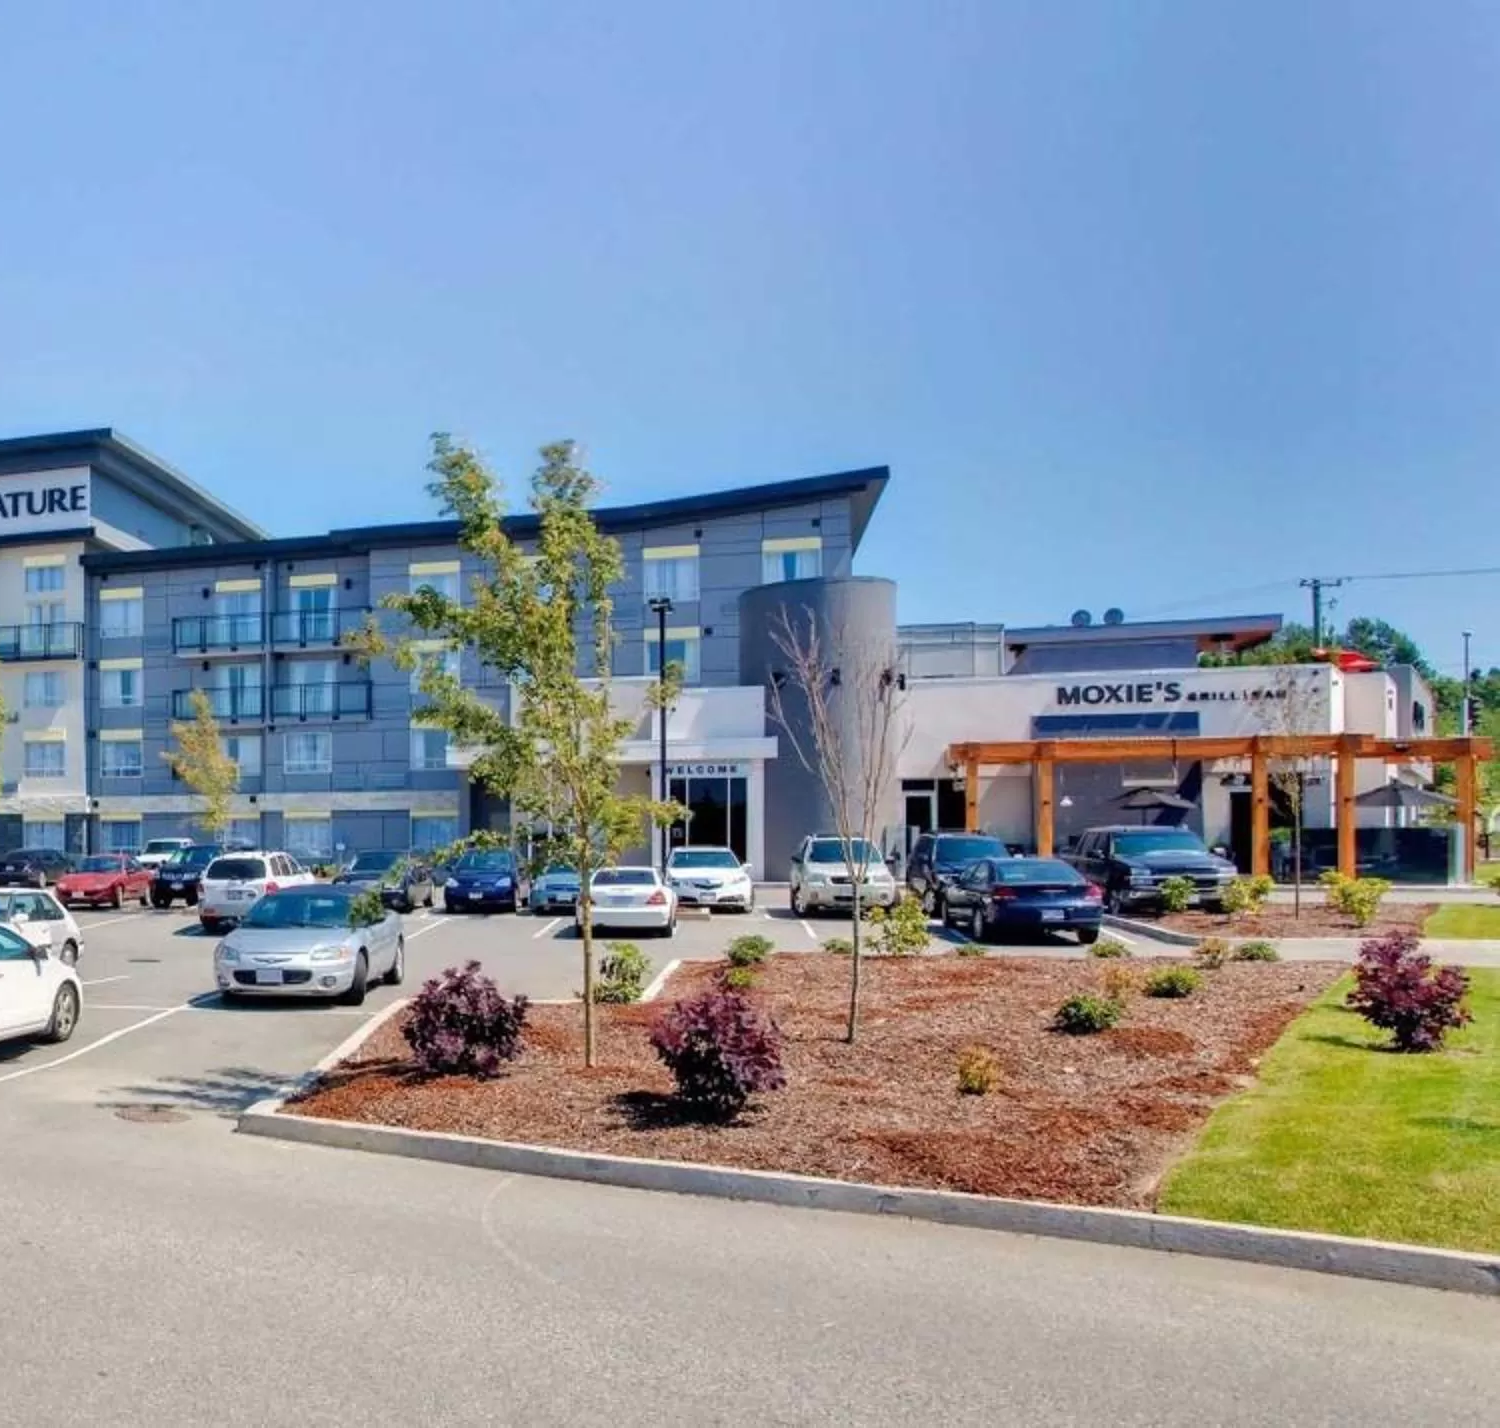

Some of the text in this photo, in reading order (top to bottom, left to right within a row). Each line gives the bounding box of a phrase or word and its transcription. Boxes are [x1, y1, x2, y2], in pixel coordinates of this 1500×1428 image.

[1057, 681, 1182, 705] MOXIE'S
[1187, 691, 1240, 702] GRILL
[665, 764, 738, 776] WELCOME
